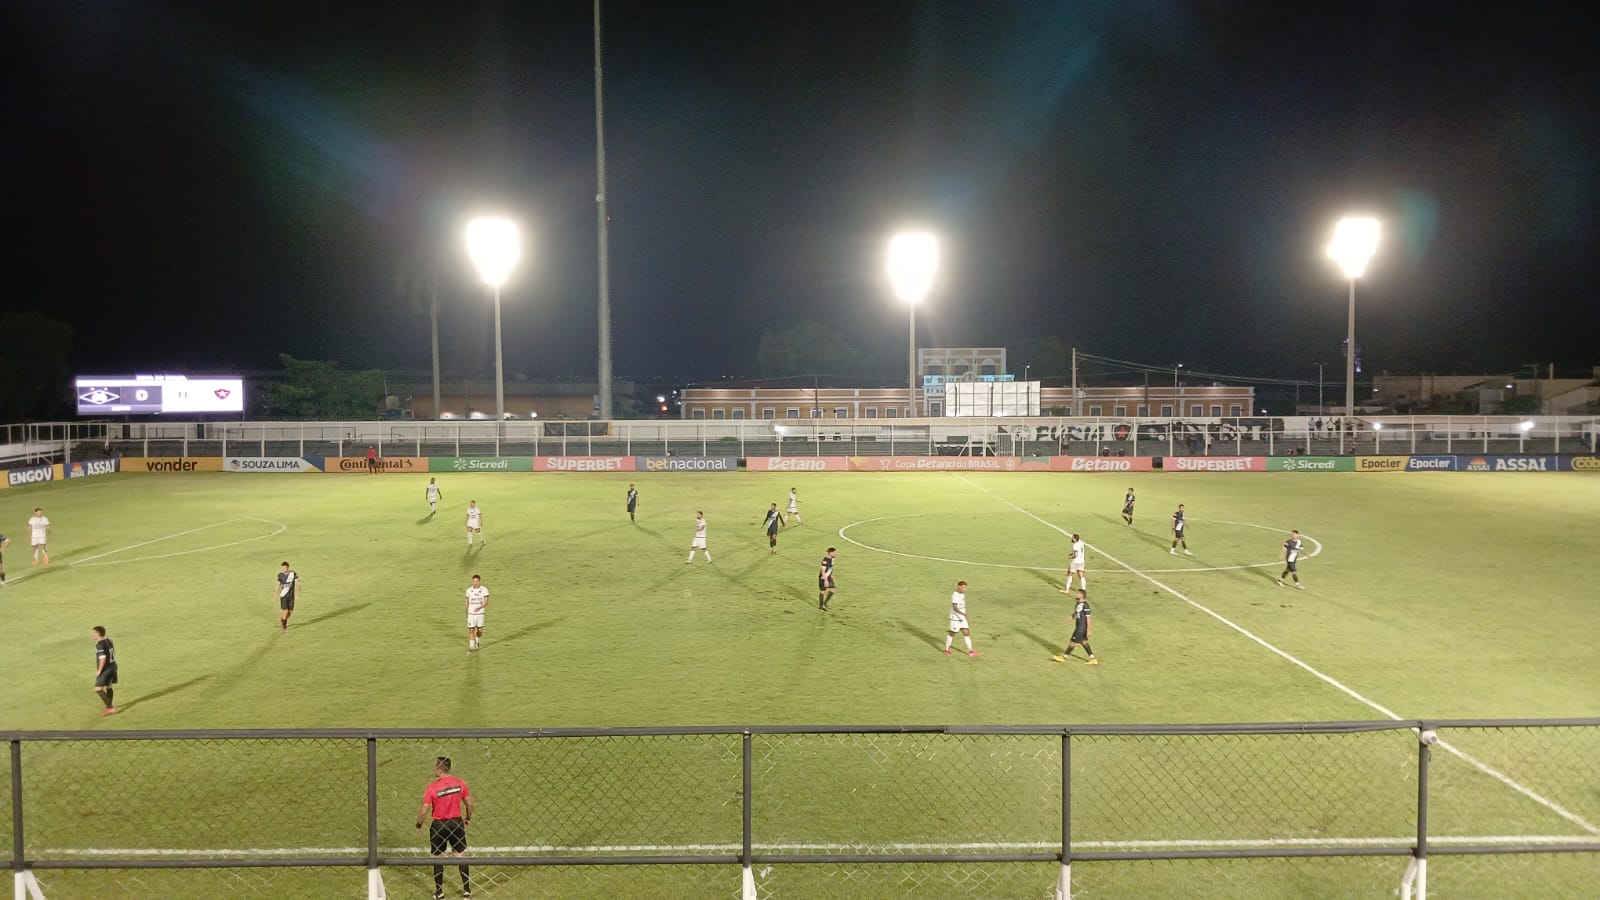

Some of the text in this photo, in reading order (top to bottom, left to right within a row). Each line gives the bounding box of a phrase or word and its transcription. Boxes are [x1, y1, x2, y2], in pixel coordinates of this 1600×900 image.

[146, 458, 197, 471] vonder
[242, 460, 300, 469] SOUZA LIMA
[469, 459, 508, 469] Sicredi
[547, 457, 623, 471] SUPERBET
[646, 457, 727, 471] betnacional
[768, 457, 826, 470] Betano
[895, 459, 1000, 469] Copa Betano do BRASIL
[1071, 457, 1131, 471] Betano
[1177, 457, 1253, 471] SUPERBET
[1297, 459, 1336, 469] Sicredi
[1361, 458, 1402, 470] Epocler
[1410, 458, 1450, 470] Epocler
[9, 467, 53, 485] ENGOV
